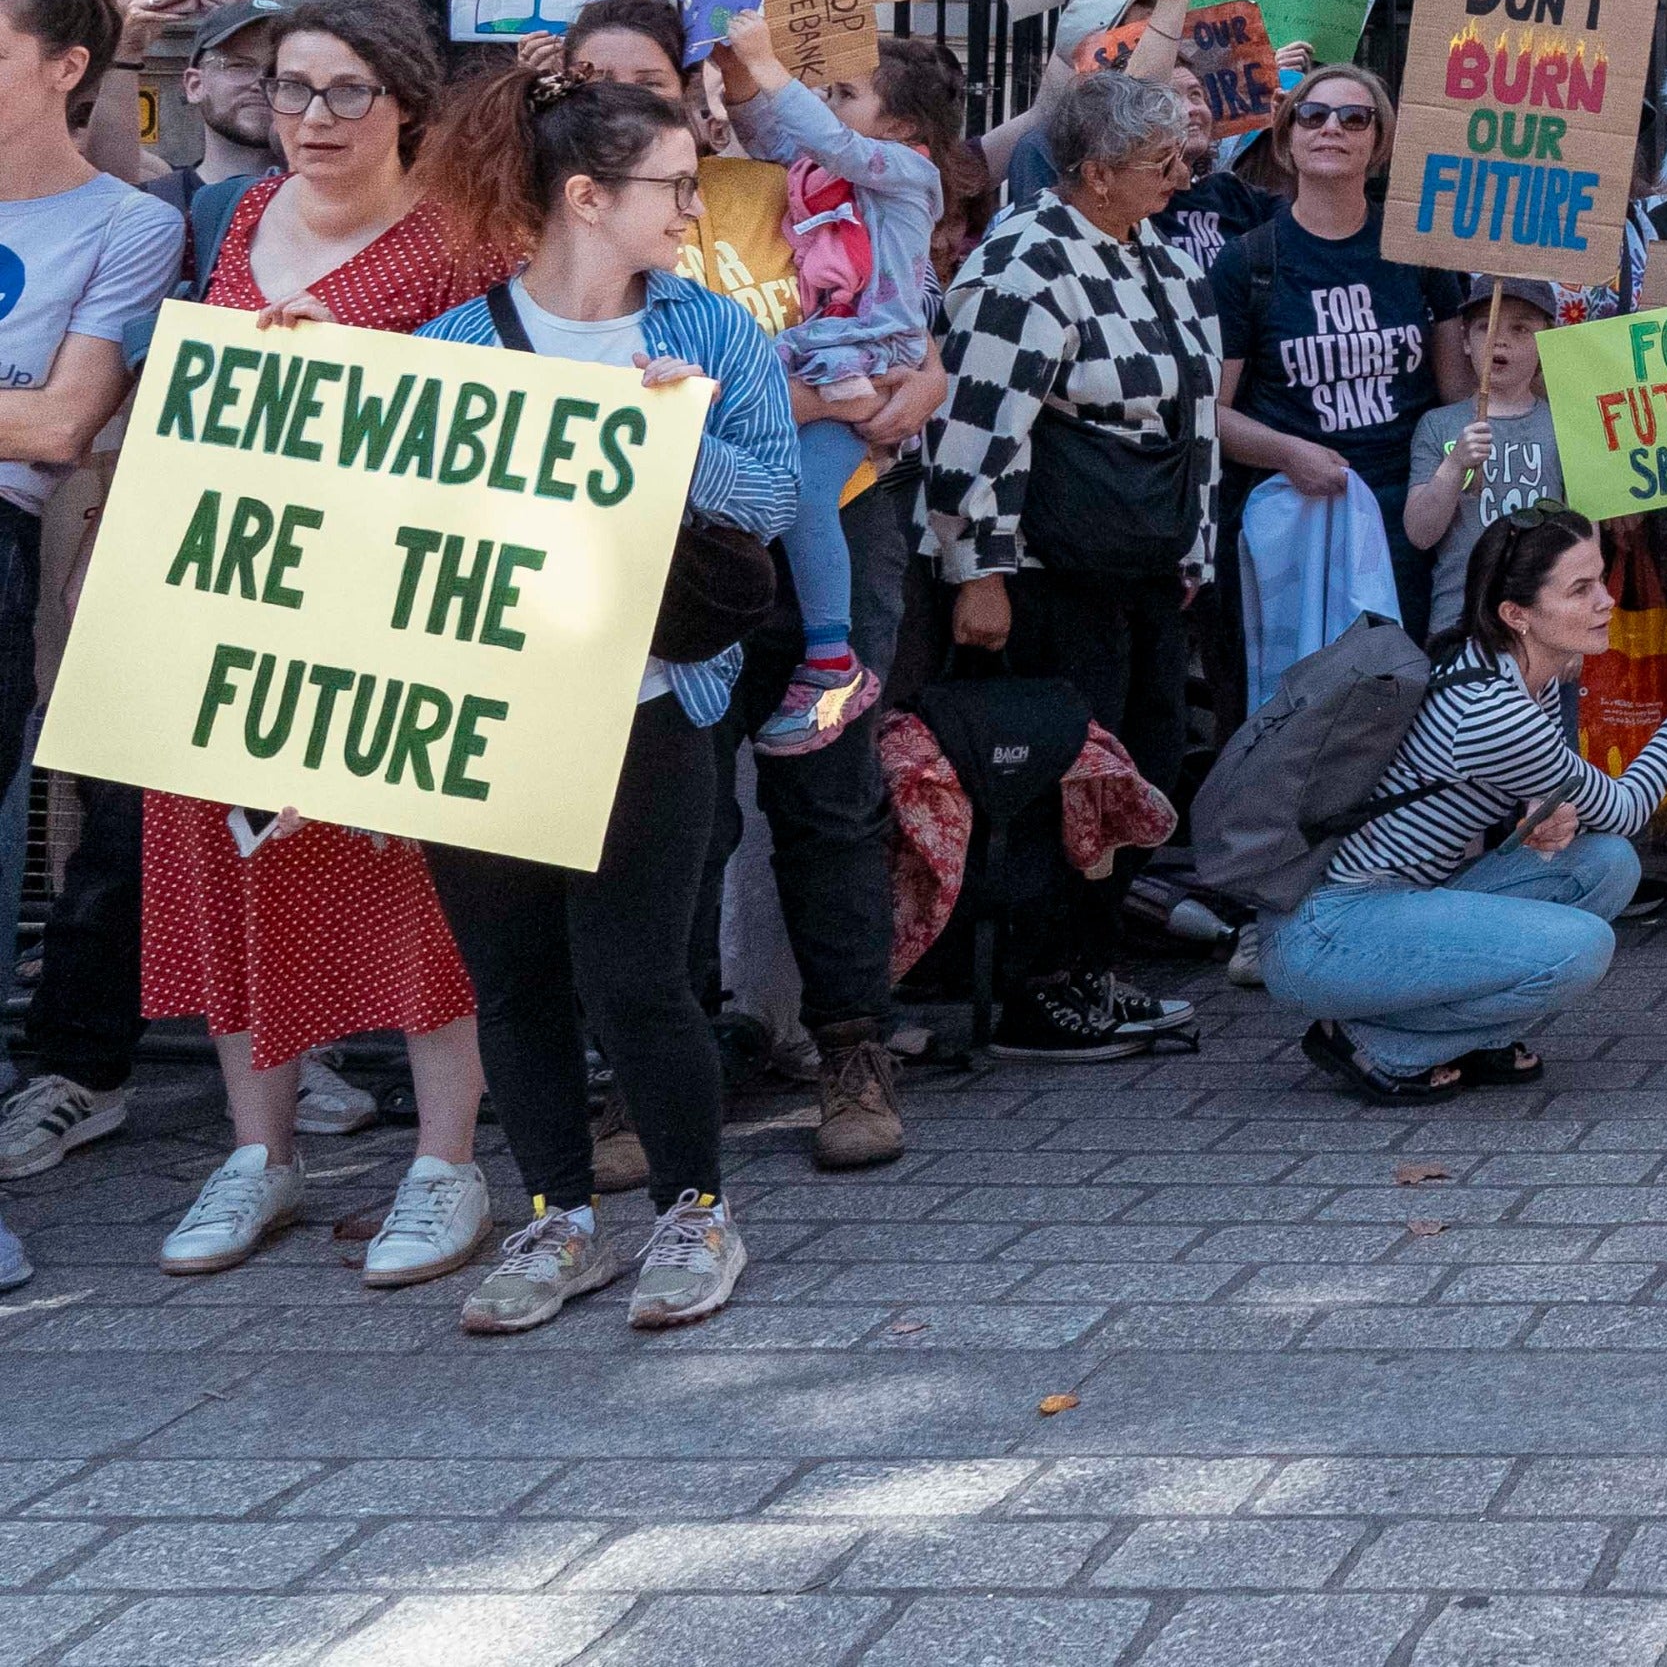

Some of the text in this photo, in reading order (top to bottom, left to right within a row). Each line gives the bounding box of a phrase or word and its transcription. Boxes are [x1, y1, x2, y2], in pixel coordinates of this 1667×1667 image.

[1193, 15, 1251, 51] OUR
[1444, 31, 1609, 114] BURN
[1465, 106, 1568, 162] OUR
[1175, 209, 1227, 247] FOR
[1415, 152, 1600, 253] FUTURE
[1310, 282, 1379, 335] FOR
[1279, 324, 1424, 389] FUTURE'S
[155, 337, 649, 509] RENEWABLES
[1311, 374, 1401, 435] SAKE
[164, 488, 549, 653] ARE THE
[190, 642, 510, 804] FUTURE
[992, 745, 1030, 764] BACH
